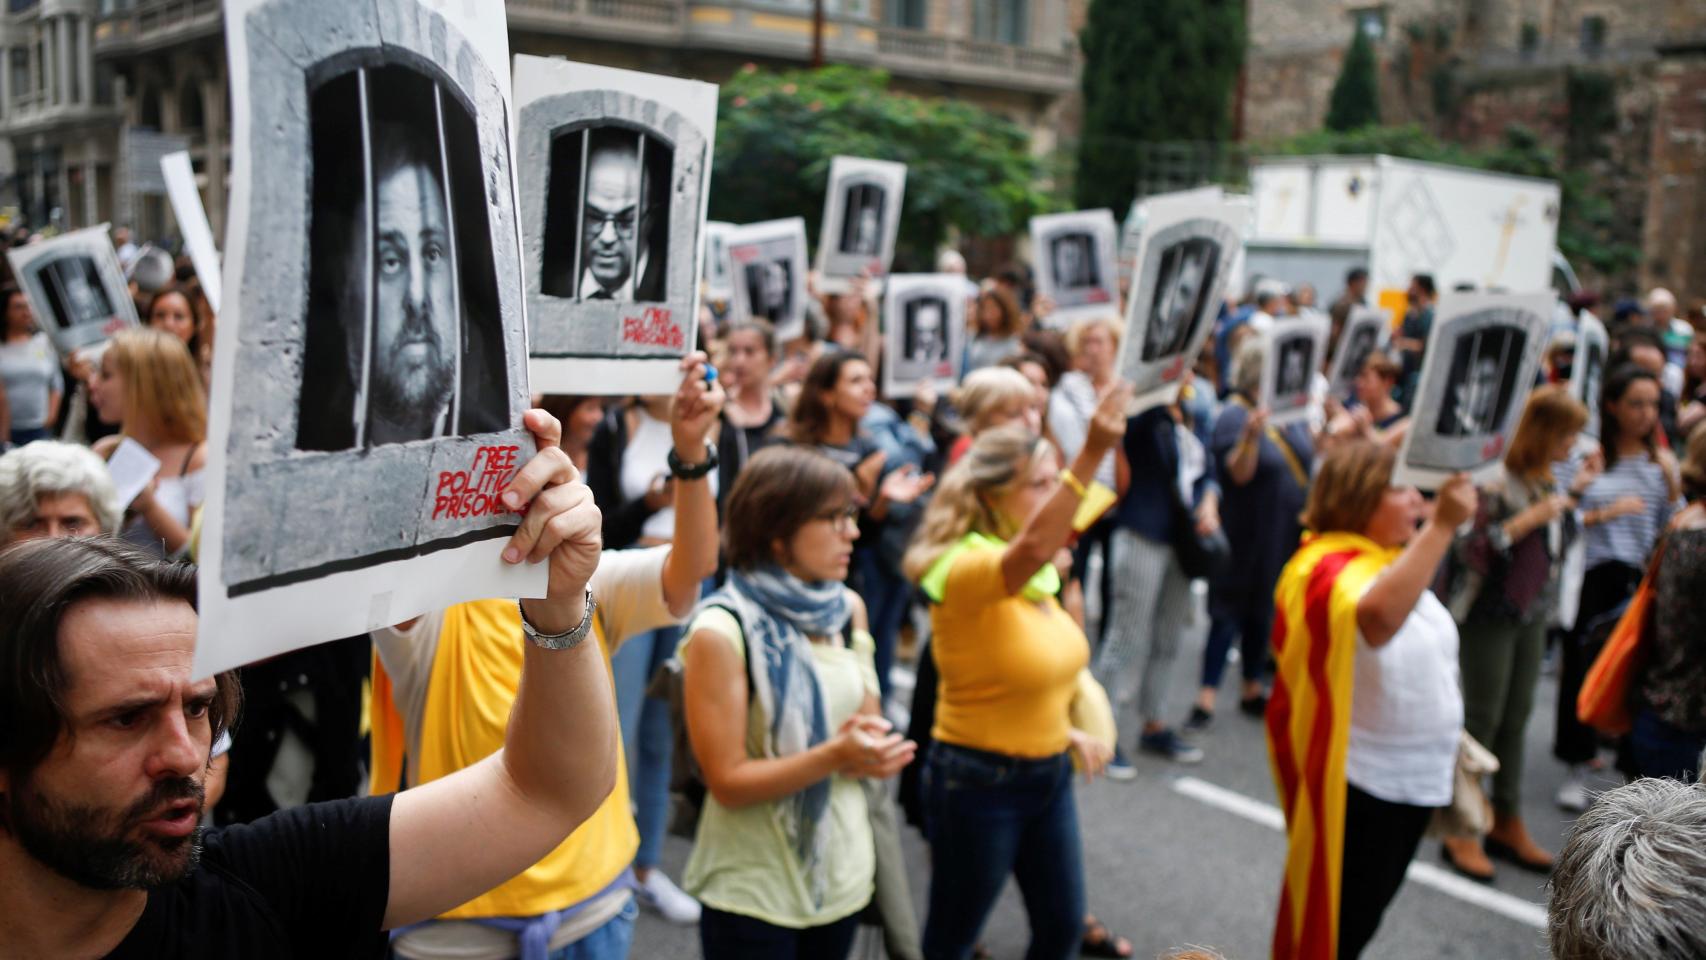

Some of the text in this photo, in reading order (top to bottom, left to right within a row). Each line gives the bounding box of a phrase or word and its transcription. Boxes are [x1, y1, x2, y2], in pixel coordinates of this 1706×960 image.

[472, 445, 520, 471] FREE
[437, 469, 512, 497] POLITIC
[432, 493, 530, 521] PRISONE
